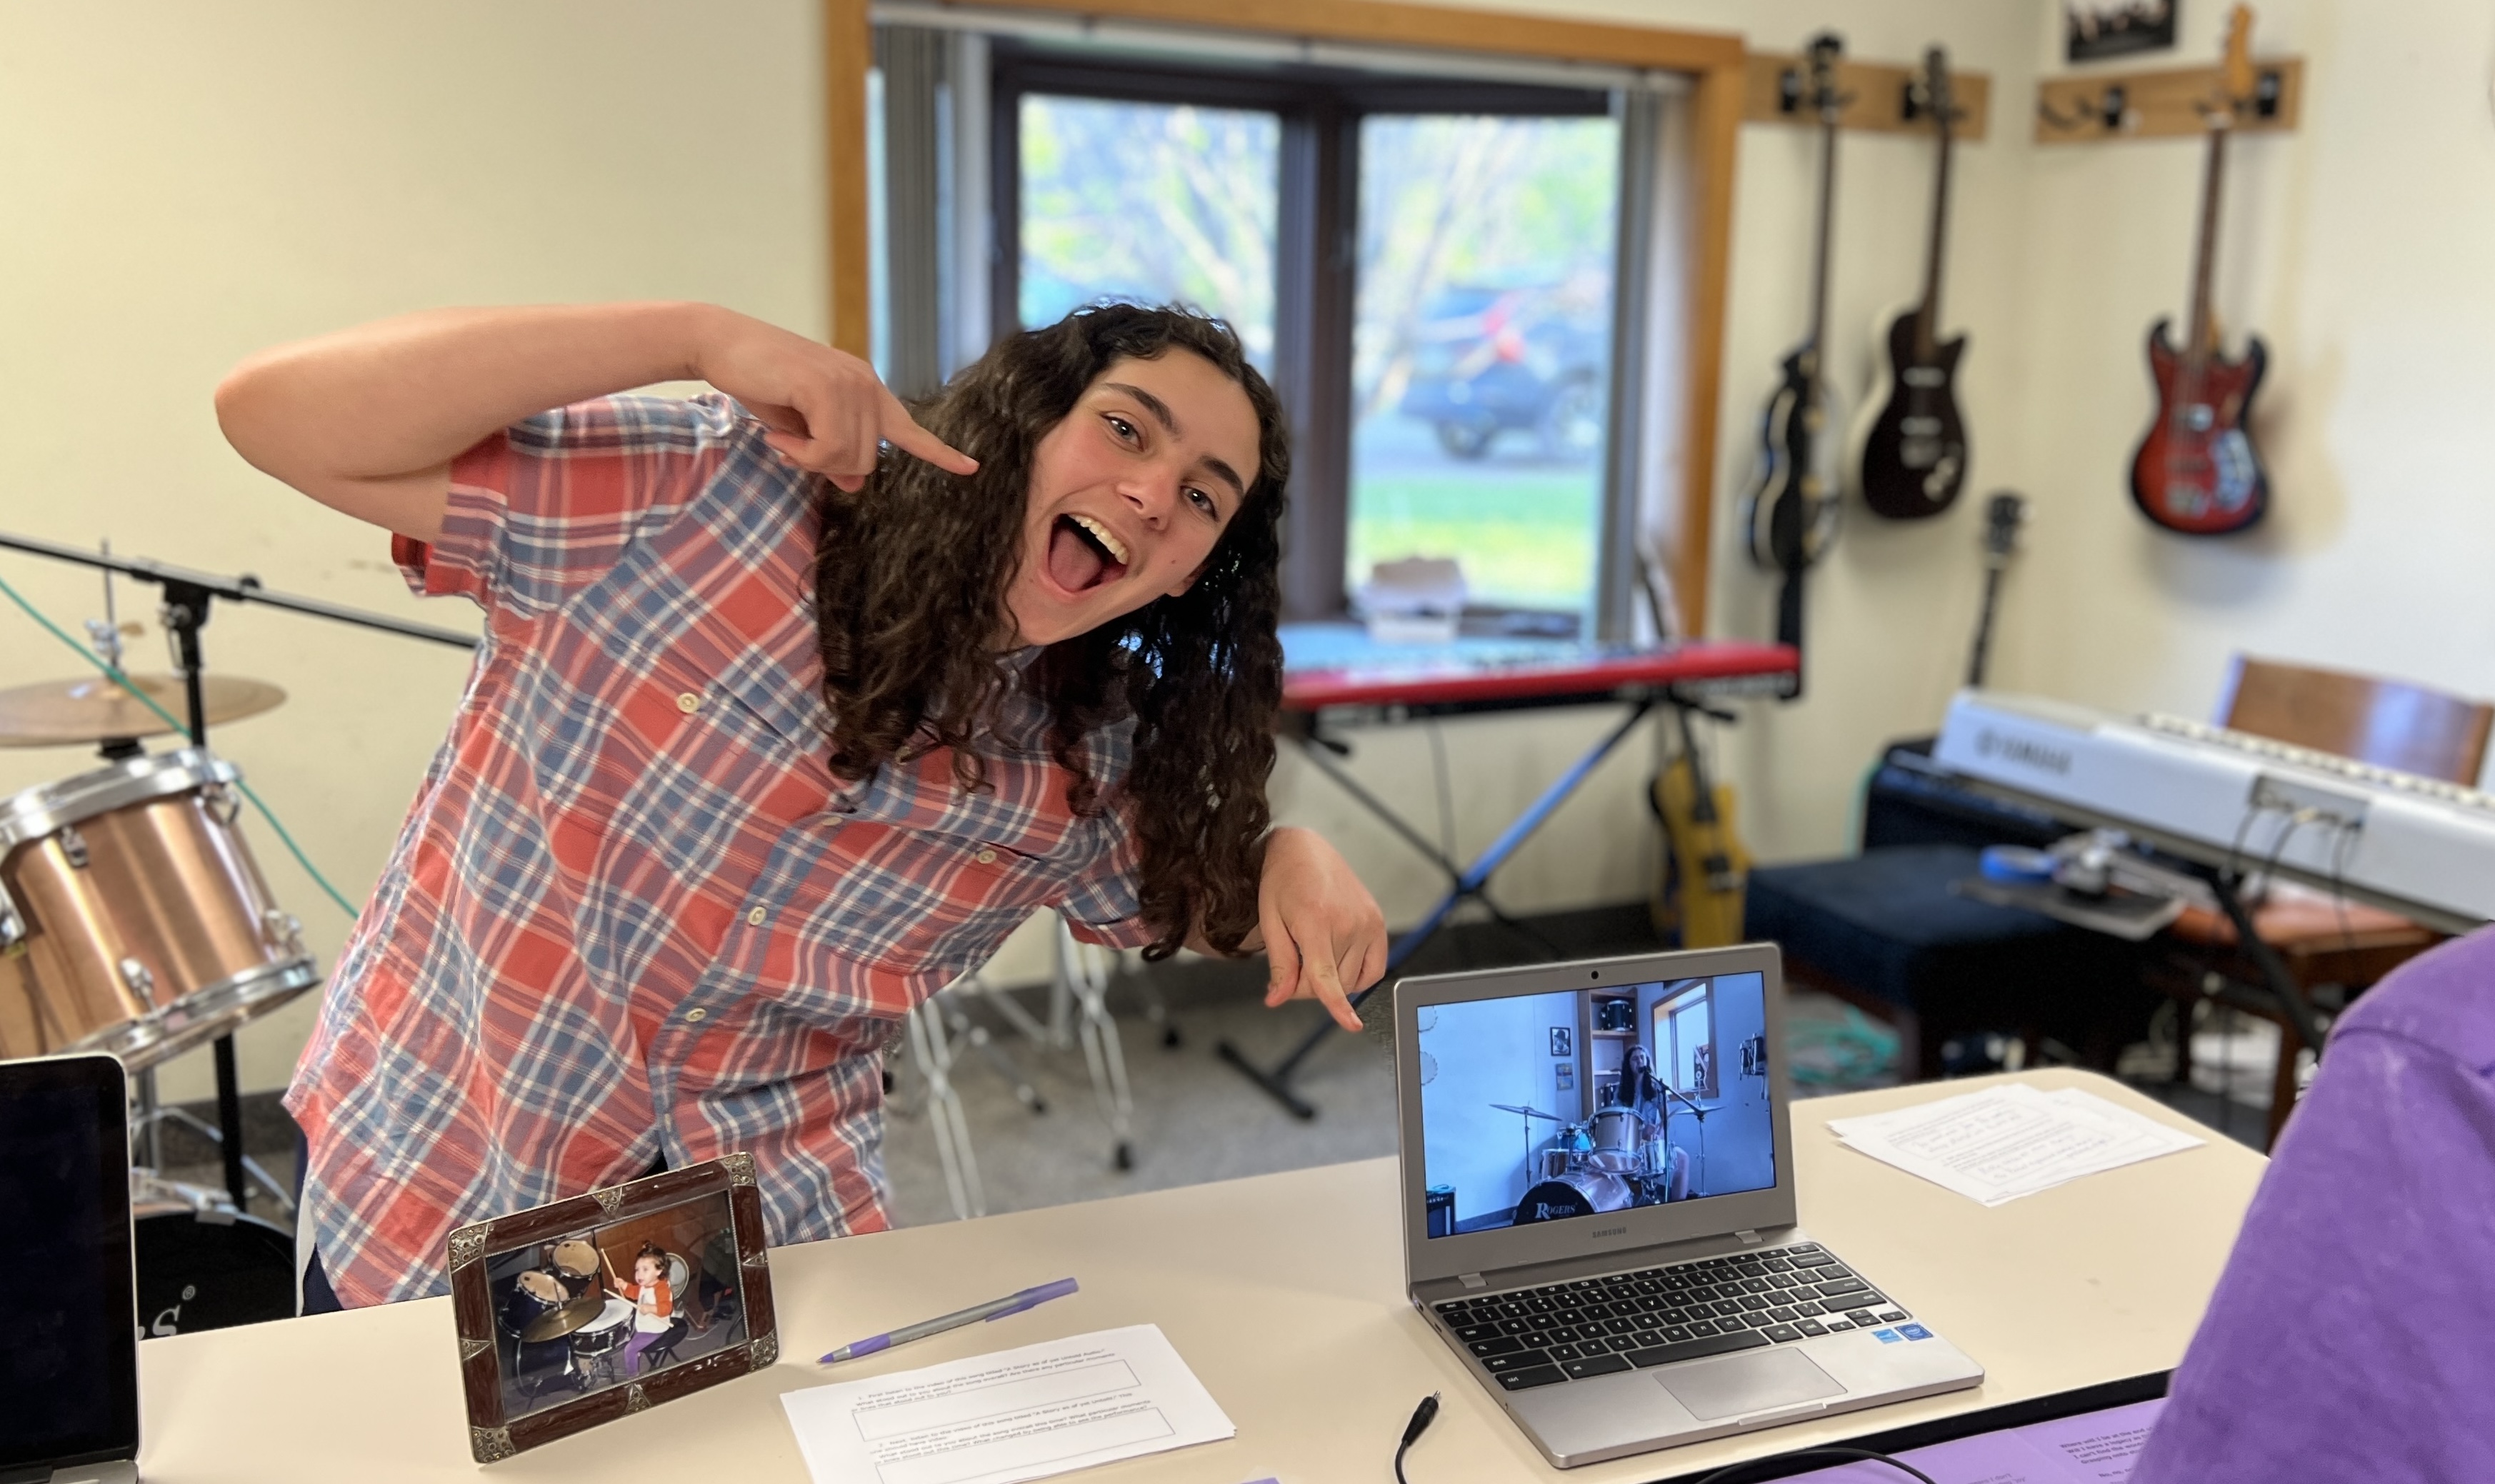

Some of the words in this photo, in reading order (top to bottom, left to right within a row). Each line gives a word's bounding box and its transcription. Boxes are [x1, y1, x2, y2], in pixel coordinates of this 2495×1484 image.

[1535, 1203, 1576, 1220] ROGERS
[1592, 1227, 1627, 1239] SAMSUNG
[2109, 1437, 2132, 1445] legacy
